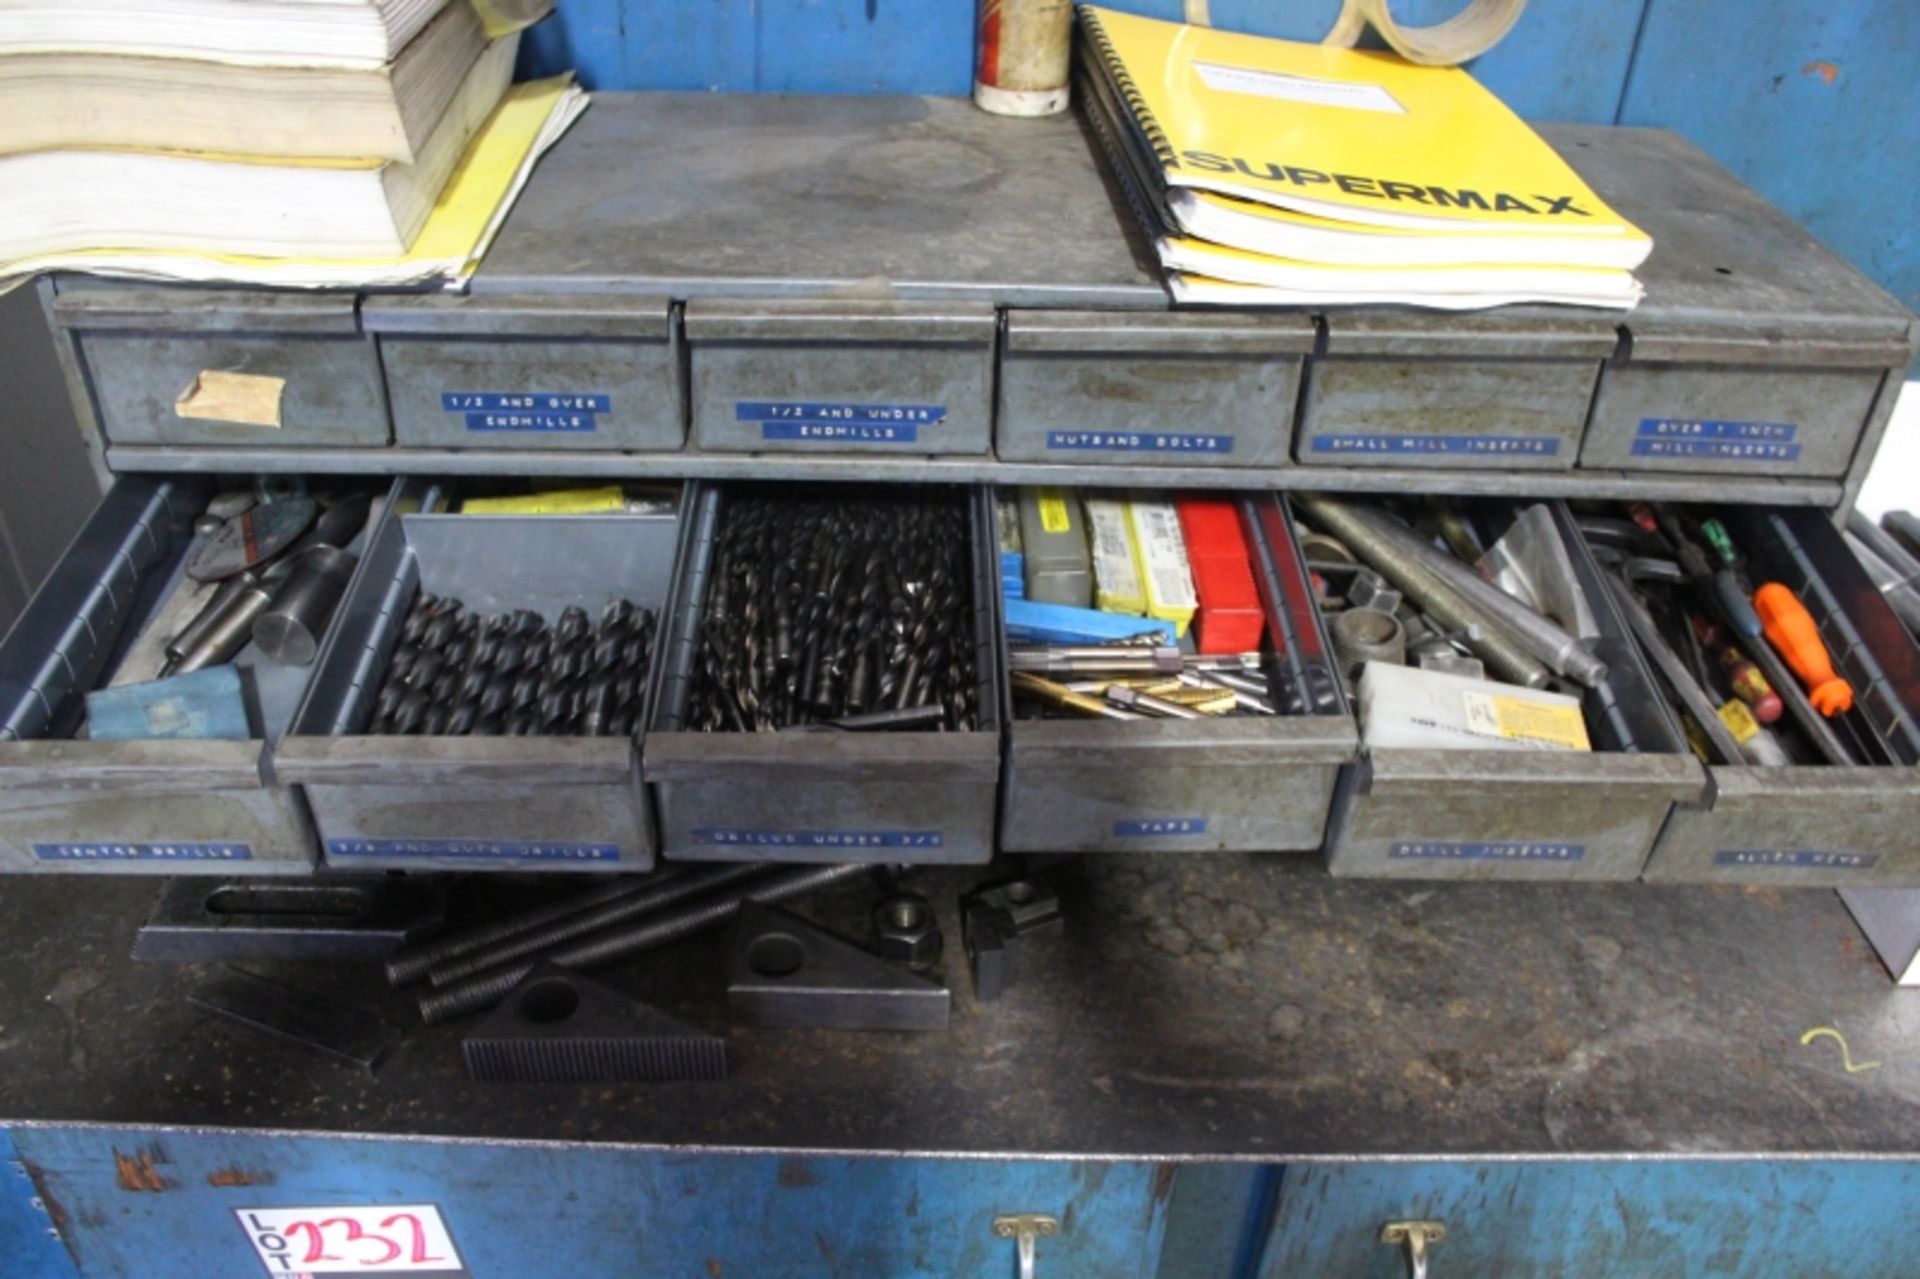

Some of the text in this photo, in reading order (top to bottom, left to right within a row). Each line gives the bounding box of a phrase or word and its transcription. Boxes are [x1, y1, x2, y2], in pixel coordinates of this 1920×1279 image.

[1183, 150, 1592, 217] SUPERMAX
[452, 397, 596, 409] 1/2 AND OVER
[772, 406, 928, 420] 1/2 AND UNDER
[486, 416, 580, 427] ENDMILLS
[801, 426, 894, 438] ENDMILLS
[1658, 423, 1702, 433] OVER
[1740, 426, 1785, 436] INCH
[1156, 437, 1217, 448] BOLTS
[1333, 438, 1388, 449] SMALL
[1403, 439, 1448, 450] MILL
[1652, 443, 1694, 453] MILL
[1141, 822, 1190, 831] TAPS
[714, 832, 796, 843] DRILLS
[813, 835, 881, 845] UNDER
[152, 847, 233, 858] DRILLS
[520, 847, 601, 859] DRILLS
[248, 1213, 292, 1270] LOT
[283, 1213, 447, 1265] 232
